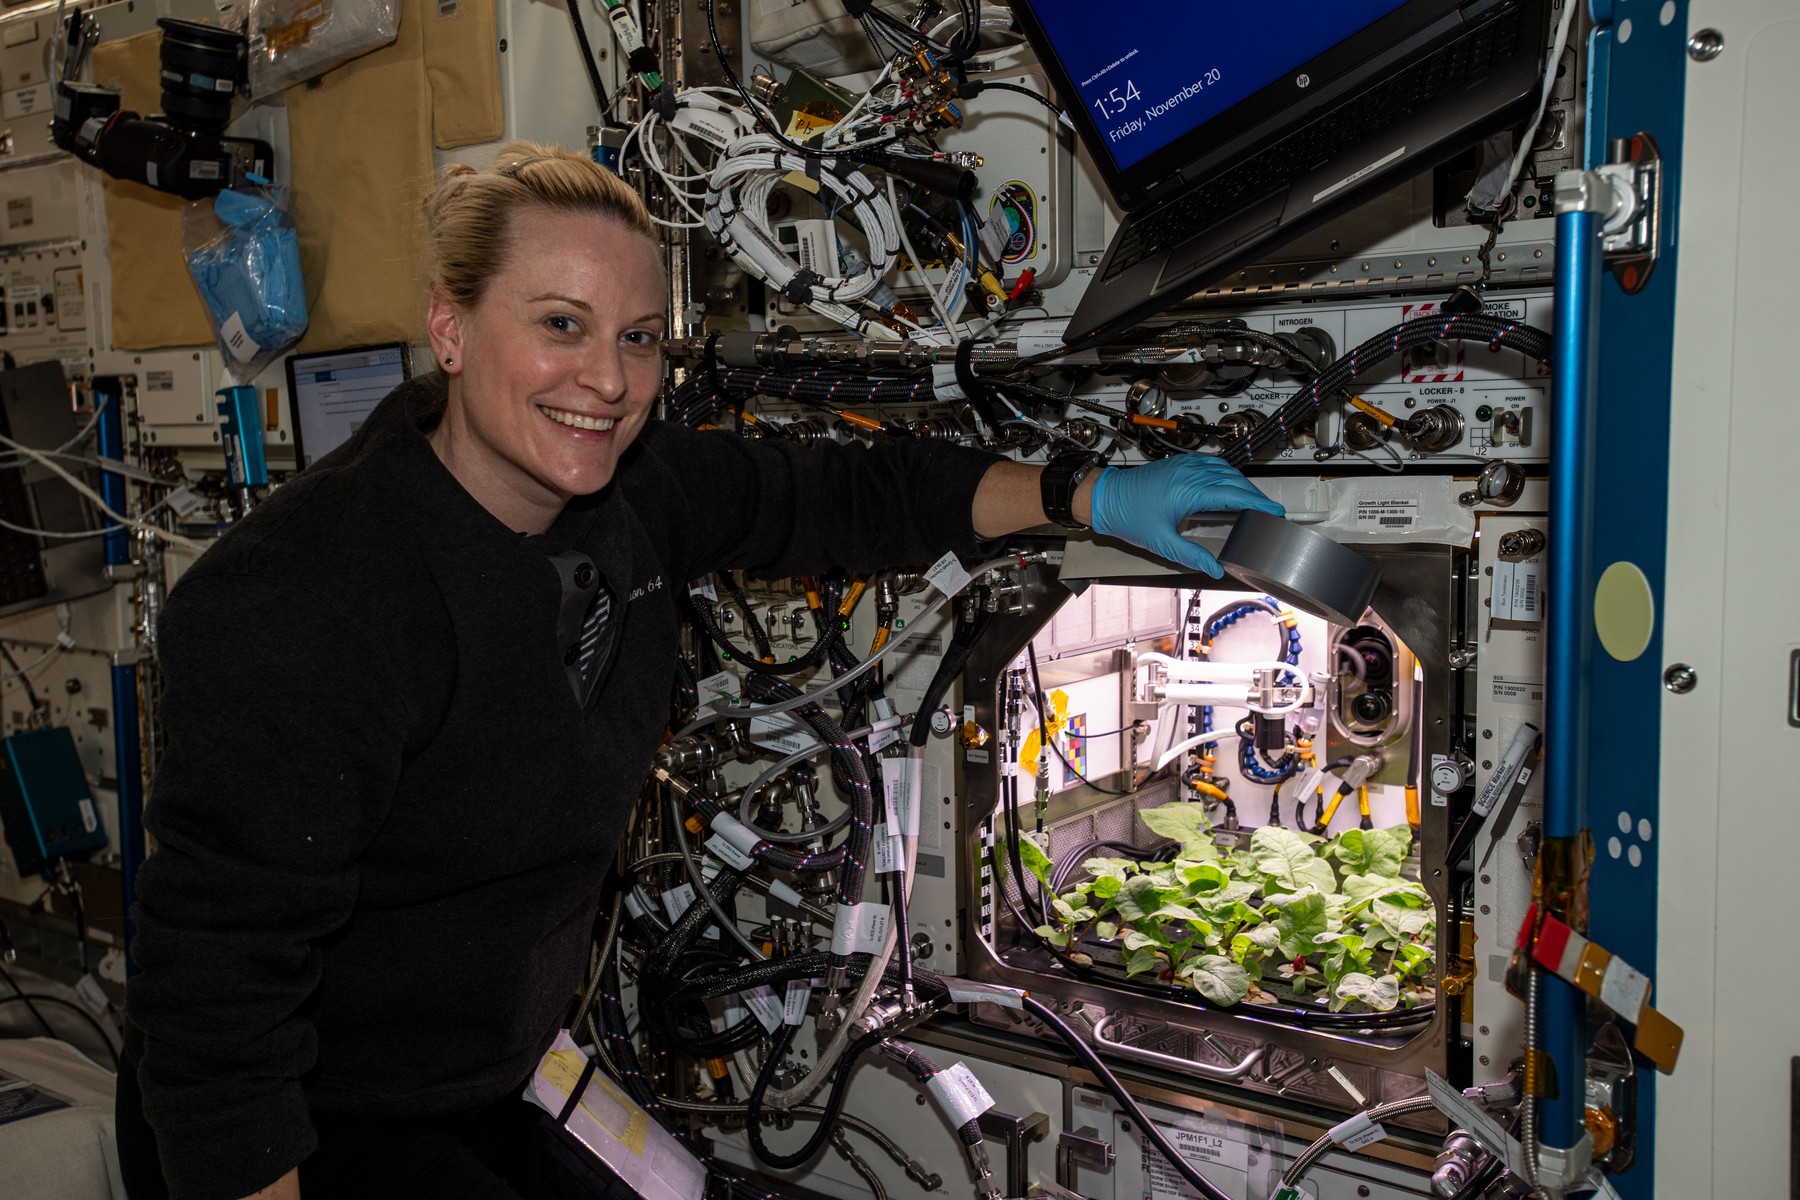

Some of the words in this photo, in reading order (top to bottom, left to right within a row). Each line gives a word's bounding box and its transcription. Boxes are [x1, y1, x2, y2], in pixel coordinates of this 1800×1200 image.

[1296, 74, 1310, 89] hp
[1094, 80, 1141, 120] 1:54
[1109, 118, 1146, 142] Friday,
[1145, 80, 1204, 120] November
[1204, 68, 1221, 86] 20
[1278, 318, 1314, 326] NITROGEN
[1280, 450, 1294, 458] G2
[1475, 446, 1487, 456] J2
[647, 576, 662, 592] 64
[1478, 782, 1496, 806] SCIENCE
[982, 847, 990, 856] 16
[982, 866, 990, 875] 14
[983, 886, 990, 894] 12
[982, 905, 990, 914] 10
[984, 926, 988, 934] 8
[1176, 1132, 1223, 1148] JPM1F1_L2
